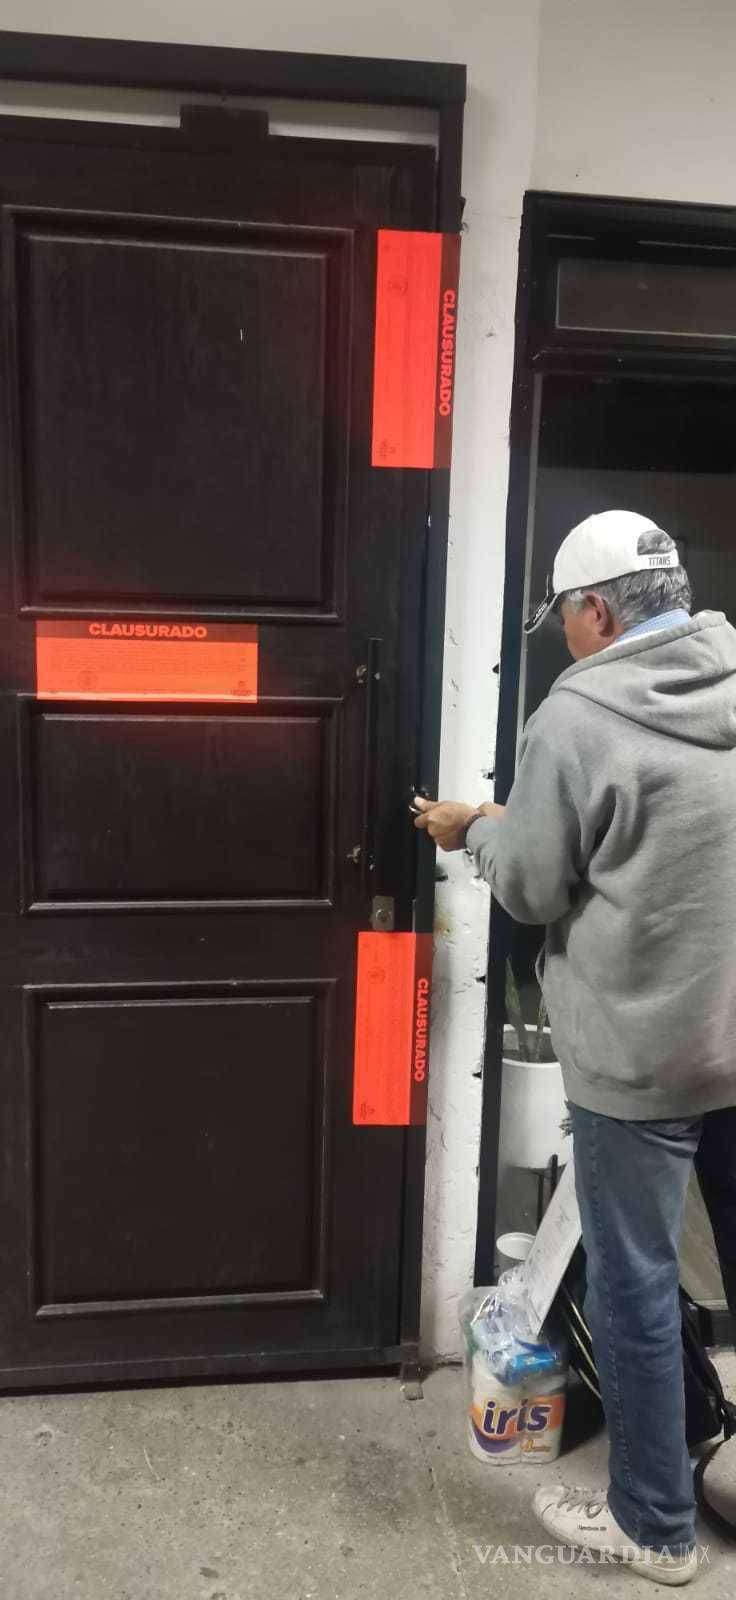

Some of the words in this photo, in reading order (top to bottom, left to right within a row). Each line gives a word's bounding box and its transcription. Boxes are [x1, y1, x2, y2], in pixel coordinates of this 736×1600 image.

[439, 290, 456, 416] CLAUSURADO
[88, 623, 208, 638] CLAUSURADO
[414, 978, 429, 1082] CLAUSURADO
[483, 1399, 552, 1435] iris
